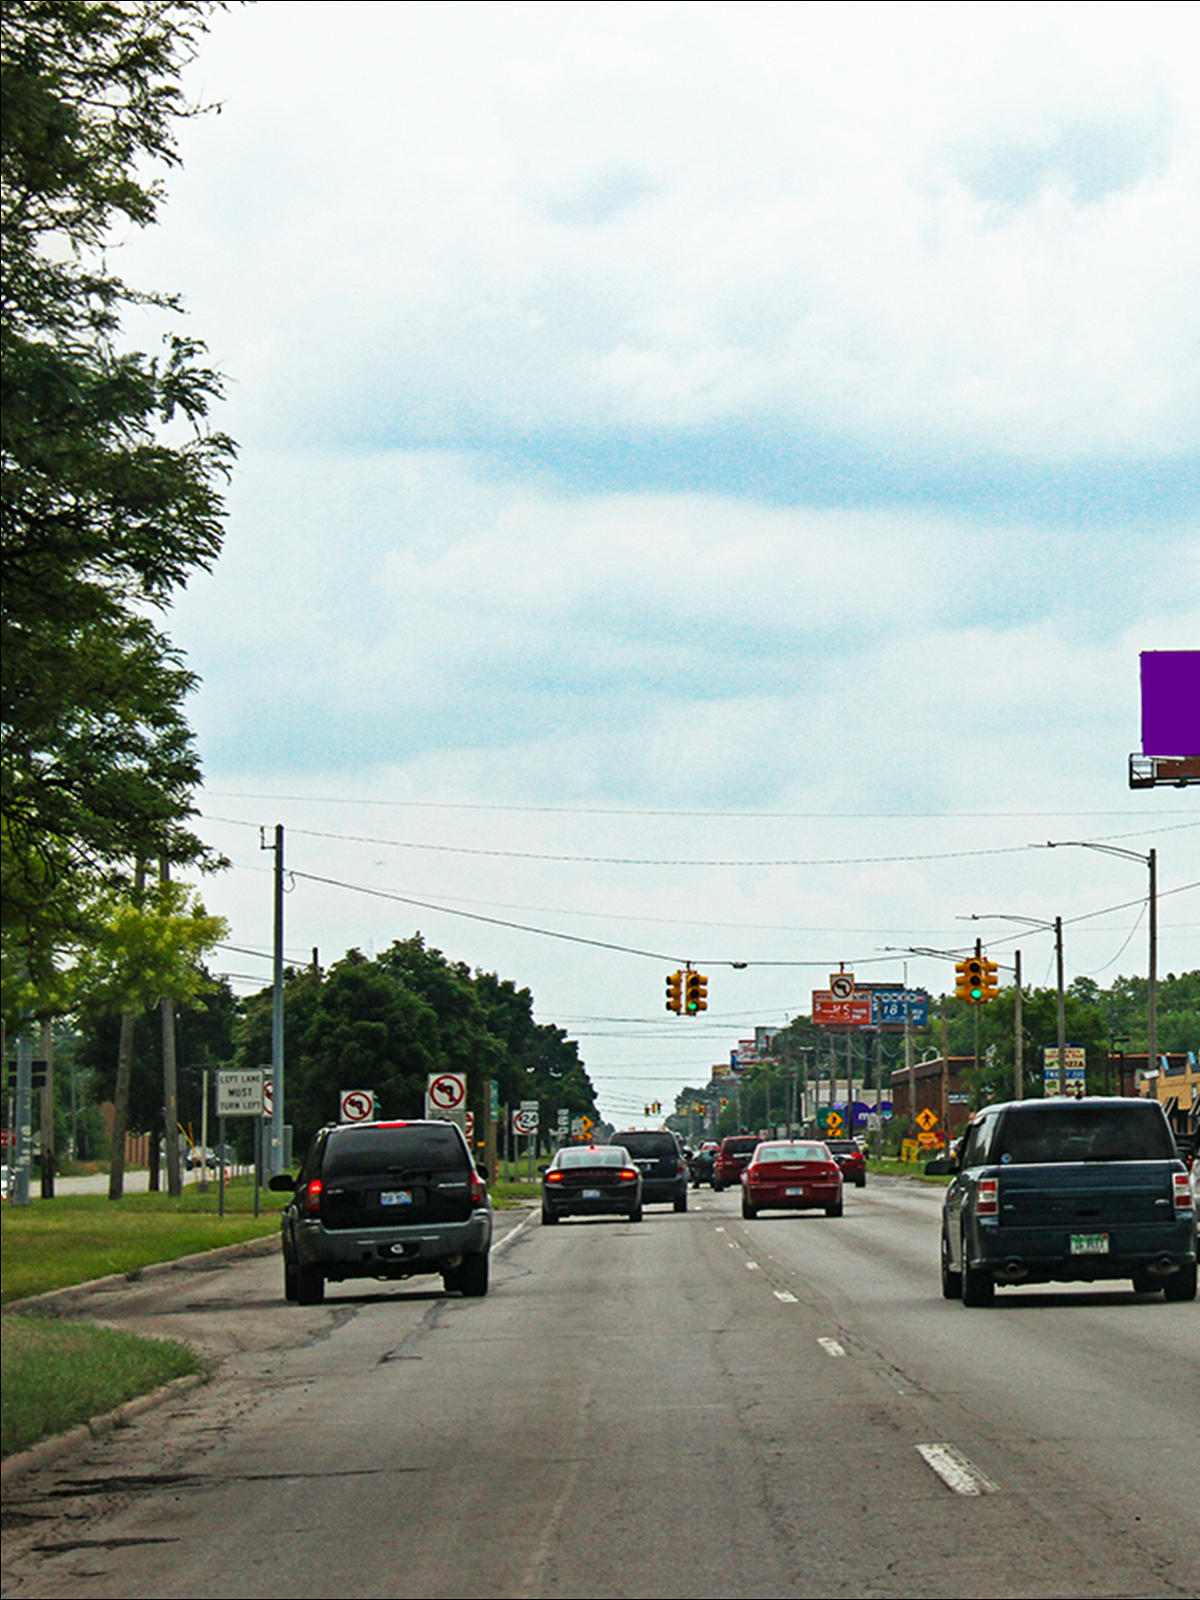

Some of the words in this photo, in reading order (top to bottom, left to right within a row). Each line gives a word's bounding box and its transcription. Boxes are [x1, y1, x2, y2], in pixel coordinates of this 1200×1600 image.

[241, 1075, 260, 1083] LANE
[228, 1088, 252, 1097] MUST
[220, 1102, 240, 1110] TURN
[243, 1101, 261, 1109] LEFT
[521, 1114, 538, 1124] 24
